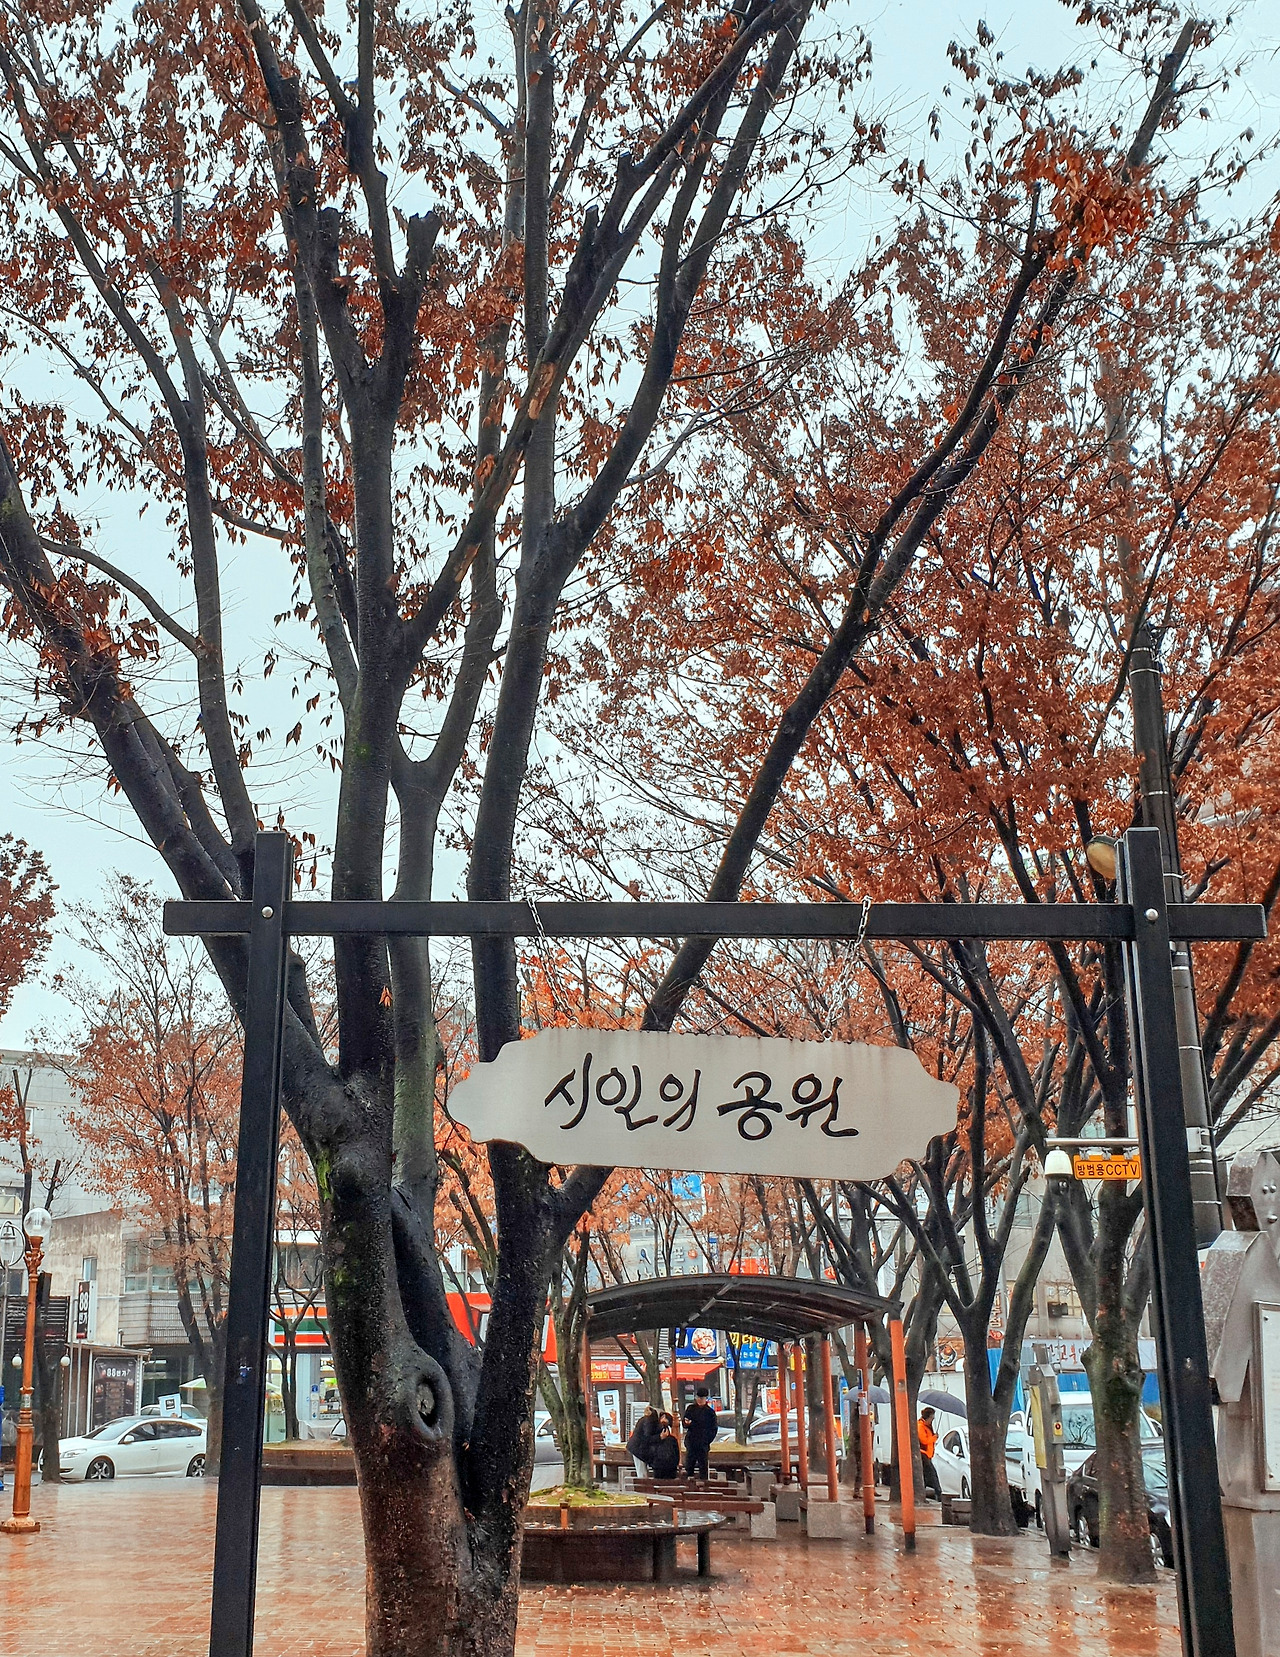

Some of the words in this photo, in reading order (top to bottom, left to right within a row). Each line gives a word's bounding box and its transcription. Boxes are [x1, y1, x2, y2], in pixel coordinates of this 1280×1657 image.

[544, 1052, 702, 1132] 시인의
[716, 1070, 860, 1141] 공원
[1077, 1163, 1138, 1176] 방범용CCTV
